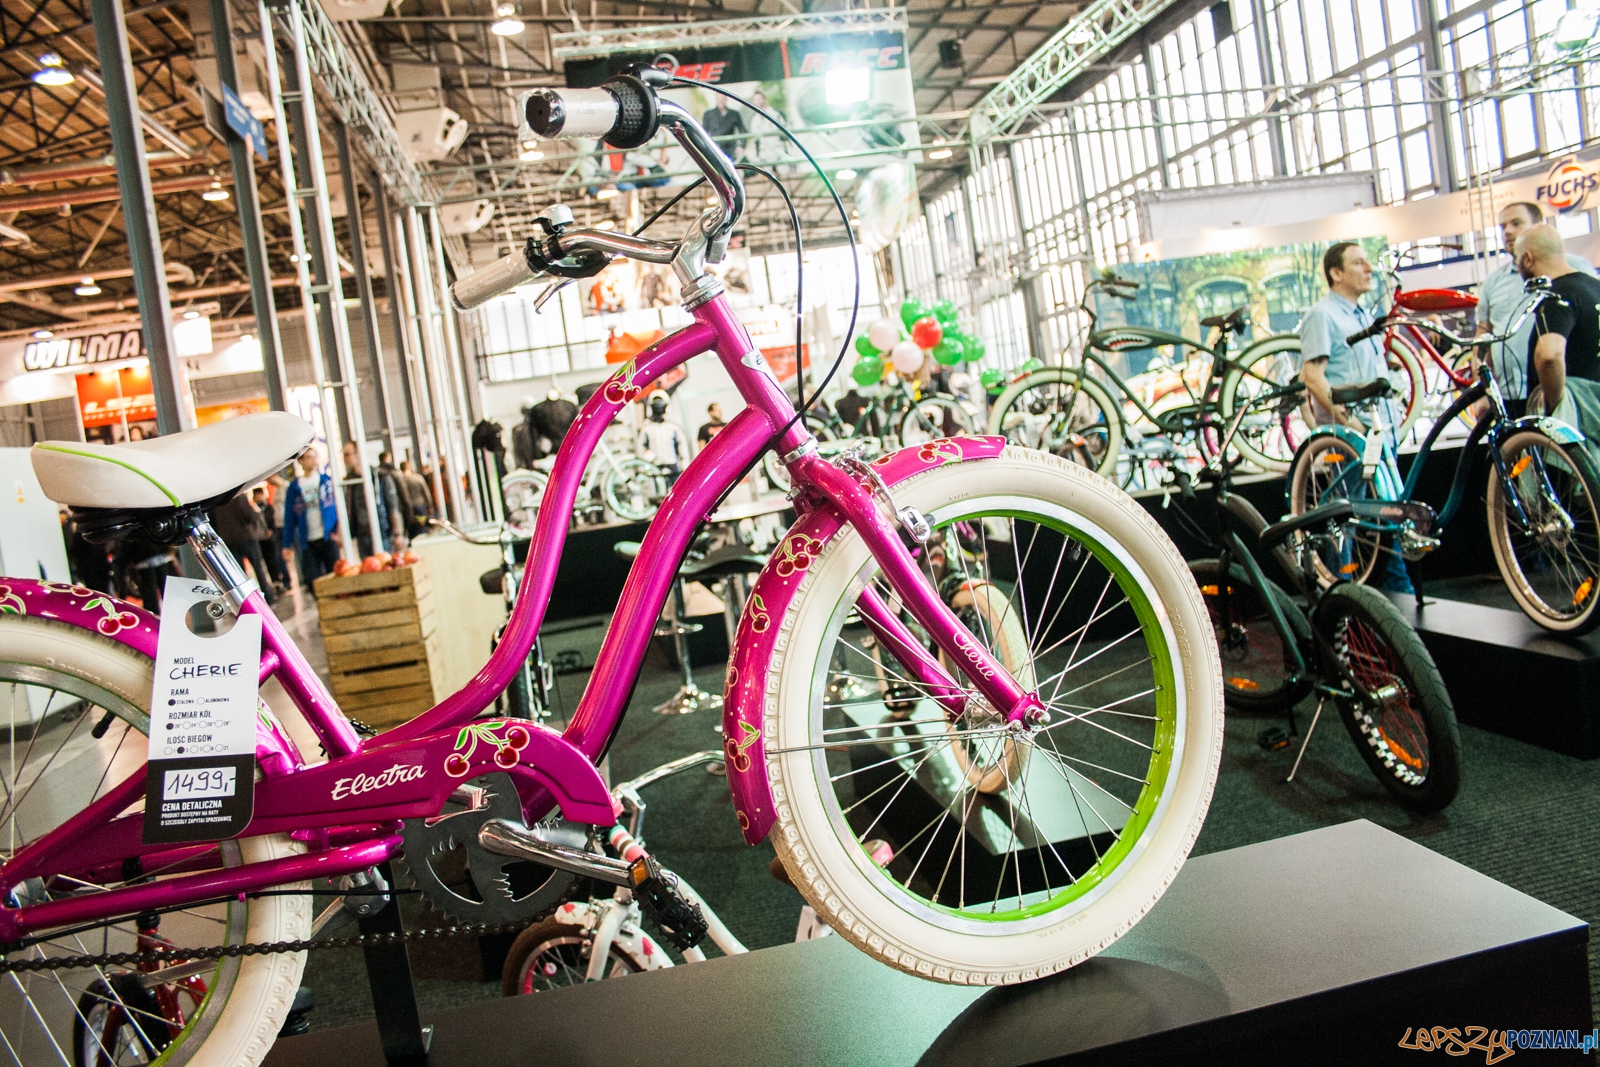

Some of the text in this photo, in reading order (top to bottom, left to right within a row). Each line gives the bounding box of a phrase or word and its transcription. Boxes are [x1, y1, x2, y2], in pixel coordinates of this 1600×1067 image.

[1536, 171, 1597, 201] FUCHS
[24, 329, 148, 372] WILMA
[191, 585, 221, 596] Elec
[173, 656, 194, 664] MODEL
[953, 630, 995, 682] Cherie
[169, 663, 242, 680] CHERIE
[168, 708, 211, 719] ROZMIAR KÓŁ
[330, 763, 428, 801] Electra
[162, 799, 222, 811] CENA DETALICZNA
